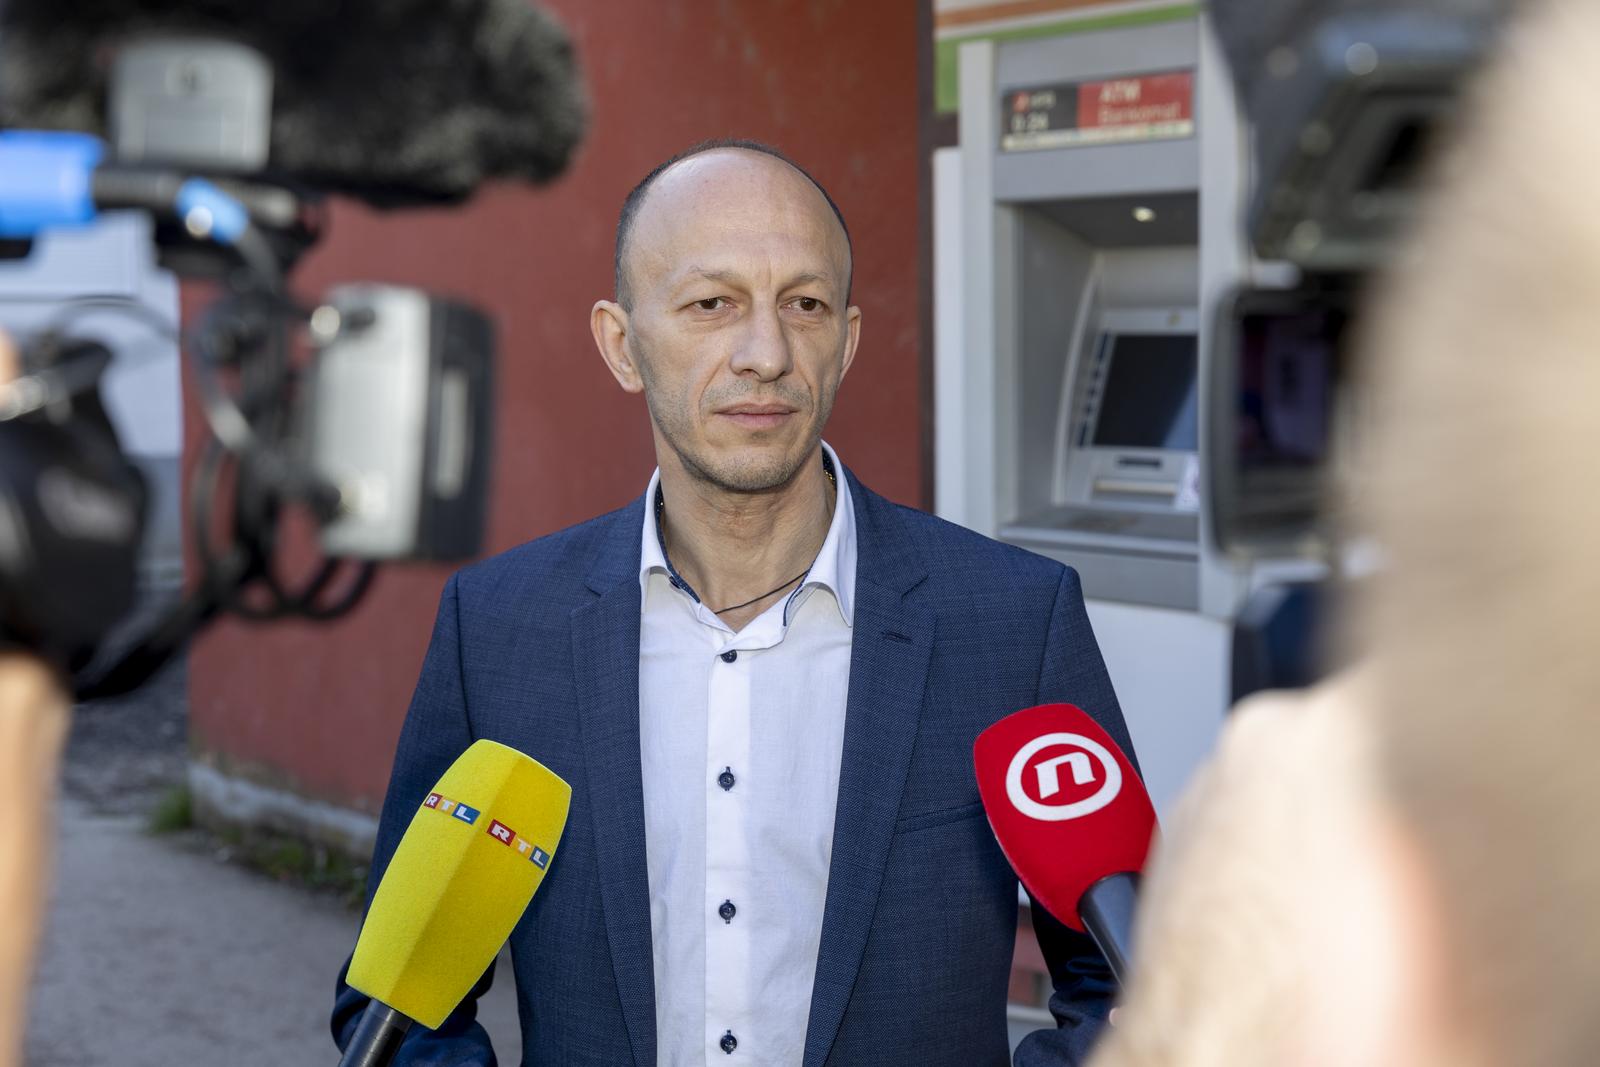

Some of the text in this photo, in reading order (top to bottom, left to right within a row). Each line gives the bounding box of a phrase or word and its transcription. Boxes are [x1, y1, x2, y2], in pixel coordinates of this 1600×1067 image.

[1100, 80, 1142, 103] ATM
[425, 795, 473, 822] RTL
[490, 823, 545, 868] RTL
